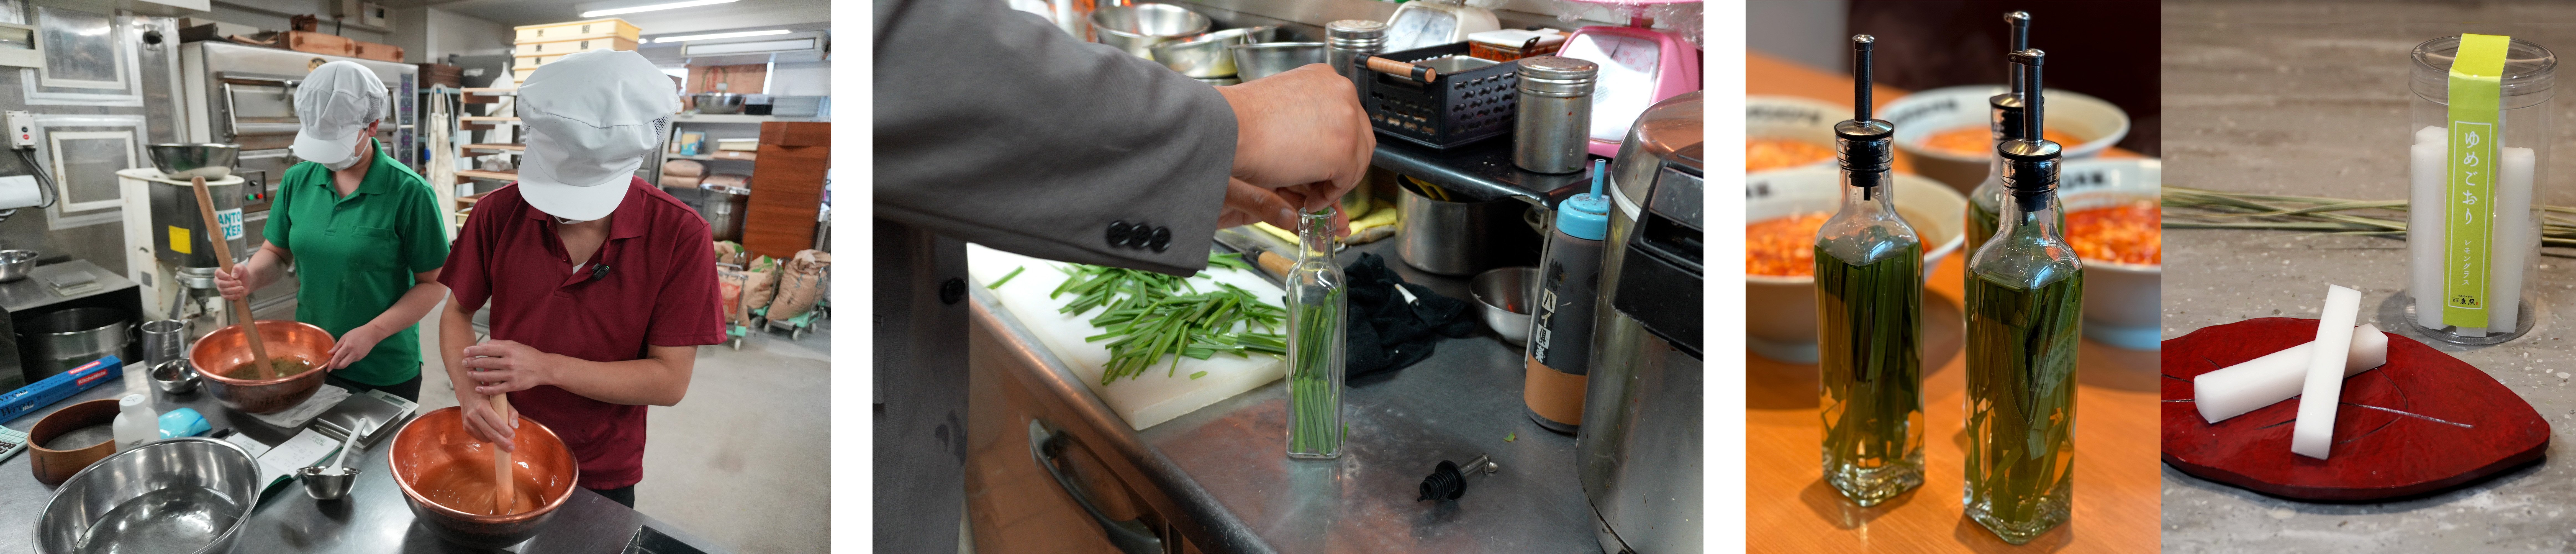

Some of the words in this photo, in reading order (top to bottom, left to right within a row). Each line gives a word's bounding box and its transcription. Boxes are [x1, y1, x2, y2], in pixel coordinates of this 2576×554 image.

[535, 44, 542, 52] 東
[535, 57, 542, 65] 東
[2462, 131, 2480, 225] ゆめごおり
[218, 211, 241, 224] ANTO
[221, 224, 241, 240] IXER
[2462, 240, 2472, 285] レモングラス
